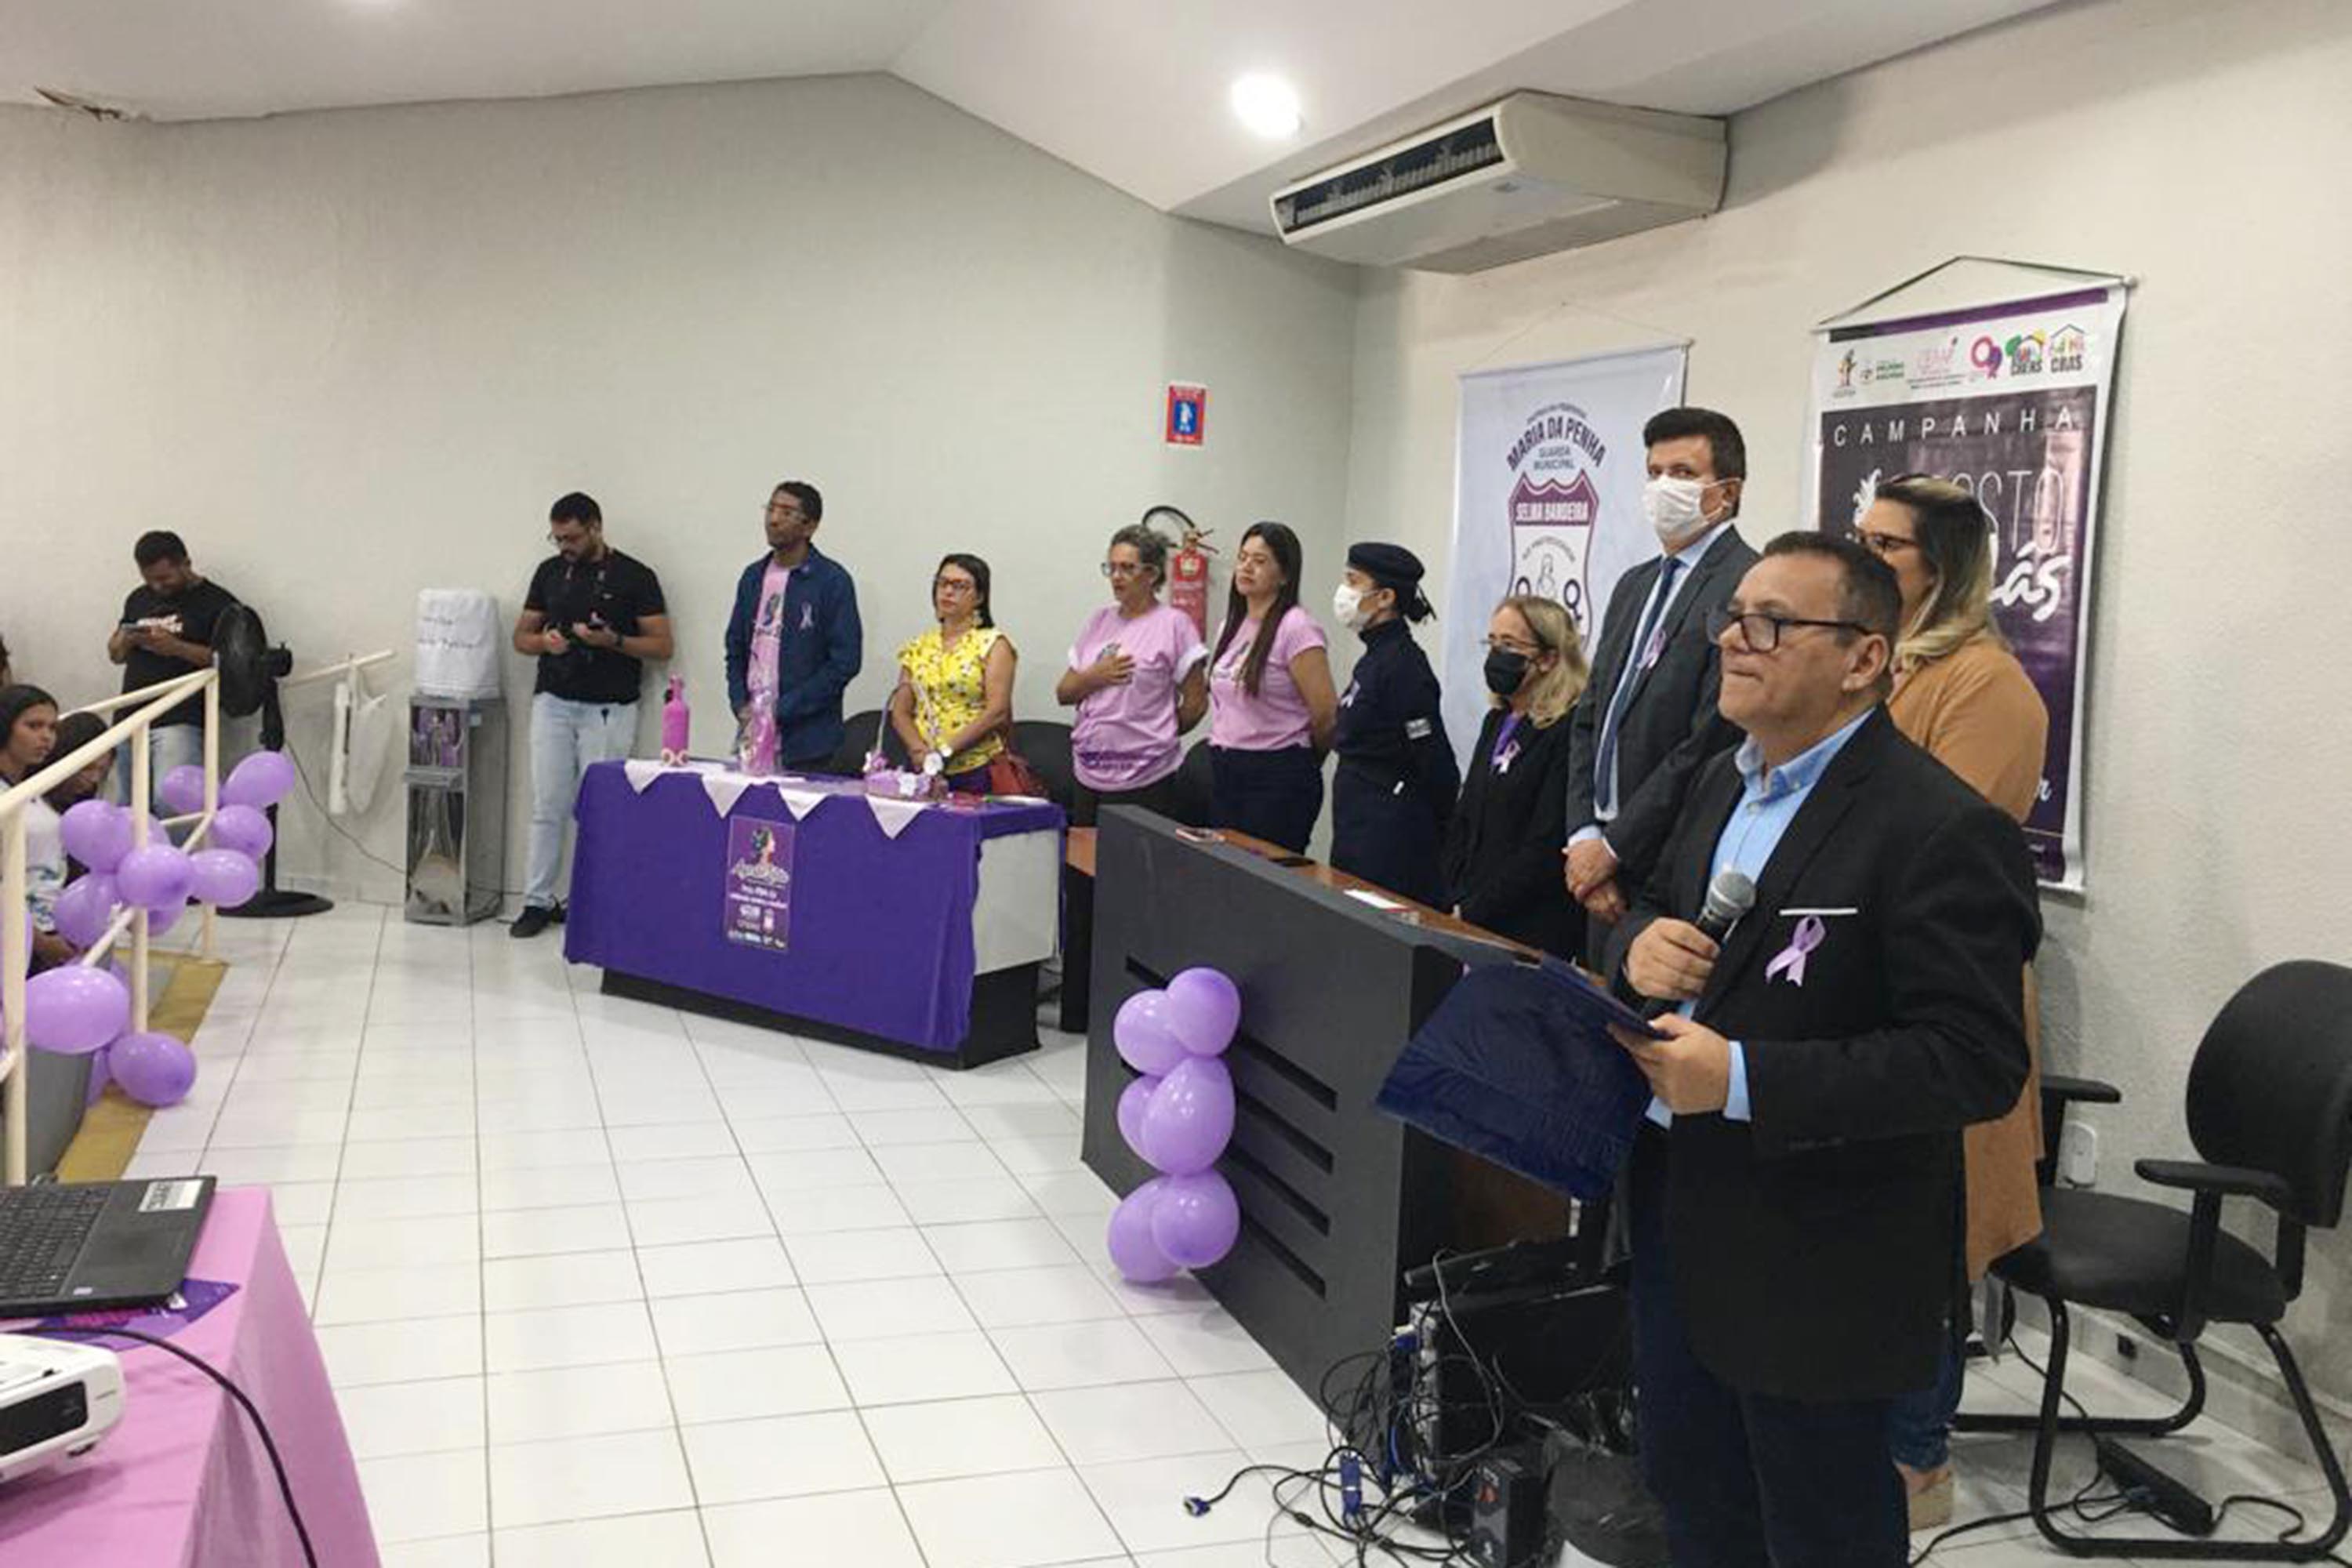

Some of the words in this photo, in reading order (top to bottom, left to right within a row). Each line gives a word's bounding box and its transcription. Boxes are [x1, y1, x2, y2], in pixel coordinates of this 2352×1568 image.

[1506, 421, 1544, 471] MARIA
[1548, 416, 1563, 439] DA
[1565, 417, 1606, 468] PENHA
[1833, 405, 2074, 447] CAMPANHA
